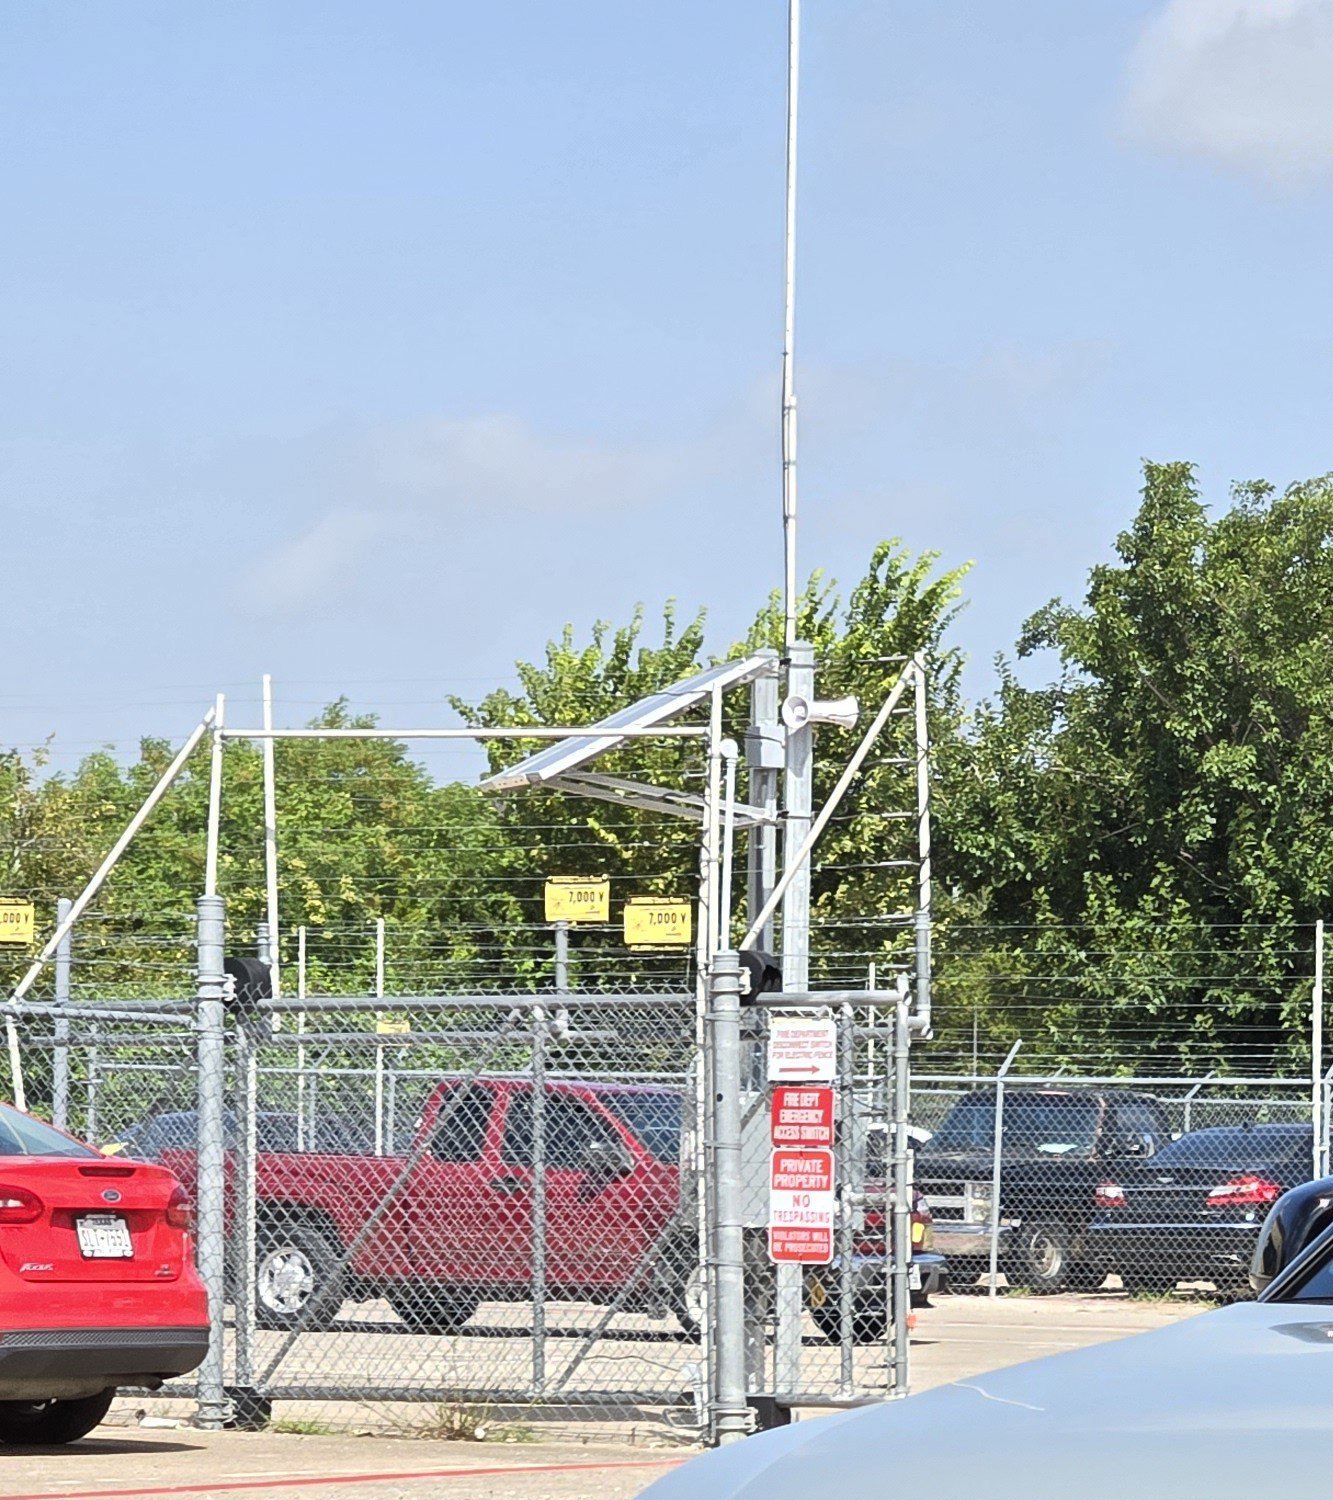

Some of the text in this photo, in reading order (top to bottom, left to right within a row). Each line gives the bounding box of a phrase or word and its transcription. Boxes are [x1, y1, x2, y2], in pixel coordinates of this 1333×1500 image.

[568, 891, 604, 904] 7,000 V
[648, 912, 686, 925] 7,000 V
[784, 1092, 820, 1107] FIRE DEPT
[779, 1109, 824, 1124] EMERGENCY
[773, 1125, 800, 1140] ACCESS
[780, 1158, 823, 1173] PRIVATE
[773, 1174, 829, 1189] PROPERTY
[792, 1194, 811, 1208] NO
[773, 1210, 830, 1223] TRESPASSING
[812, 1231, 829, 1242] WILL
